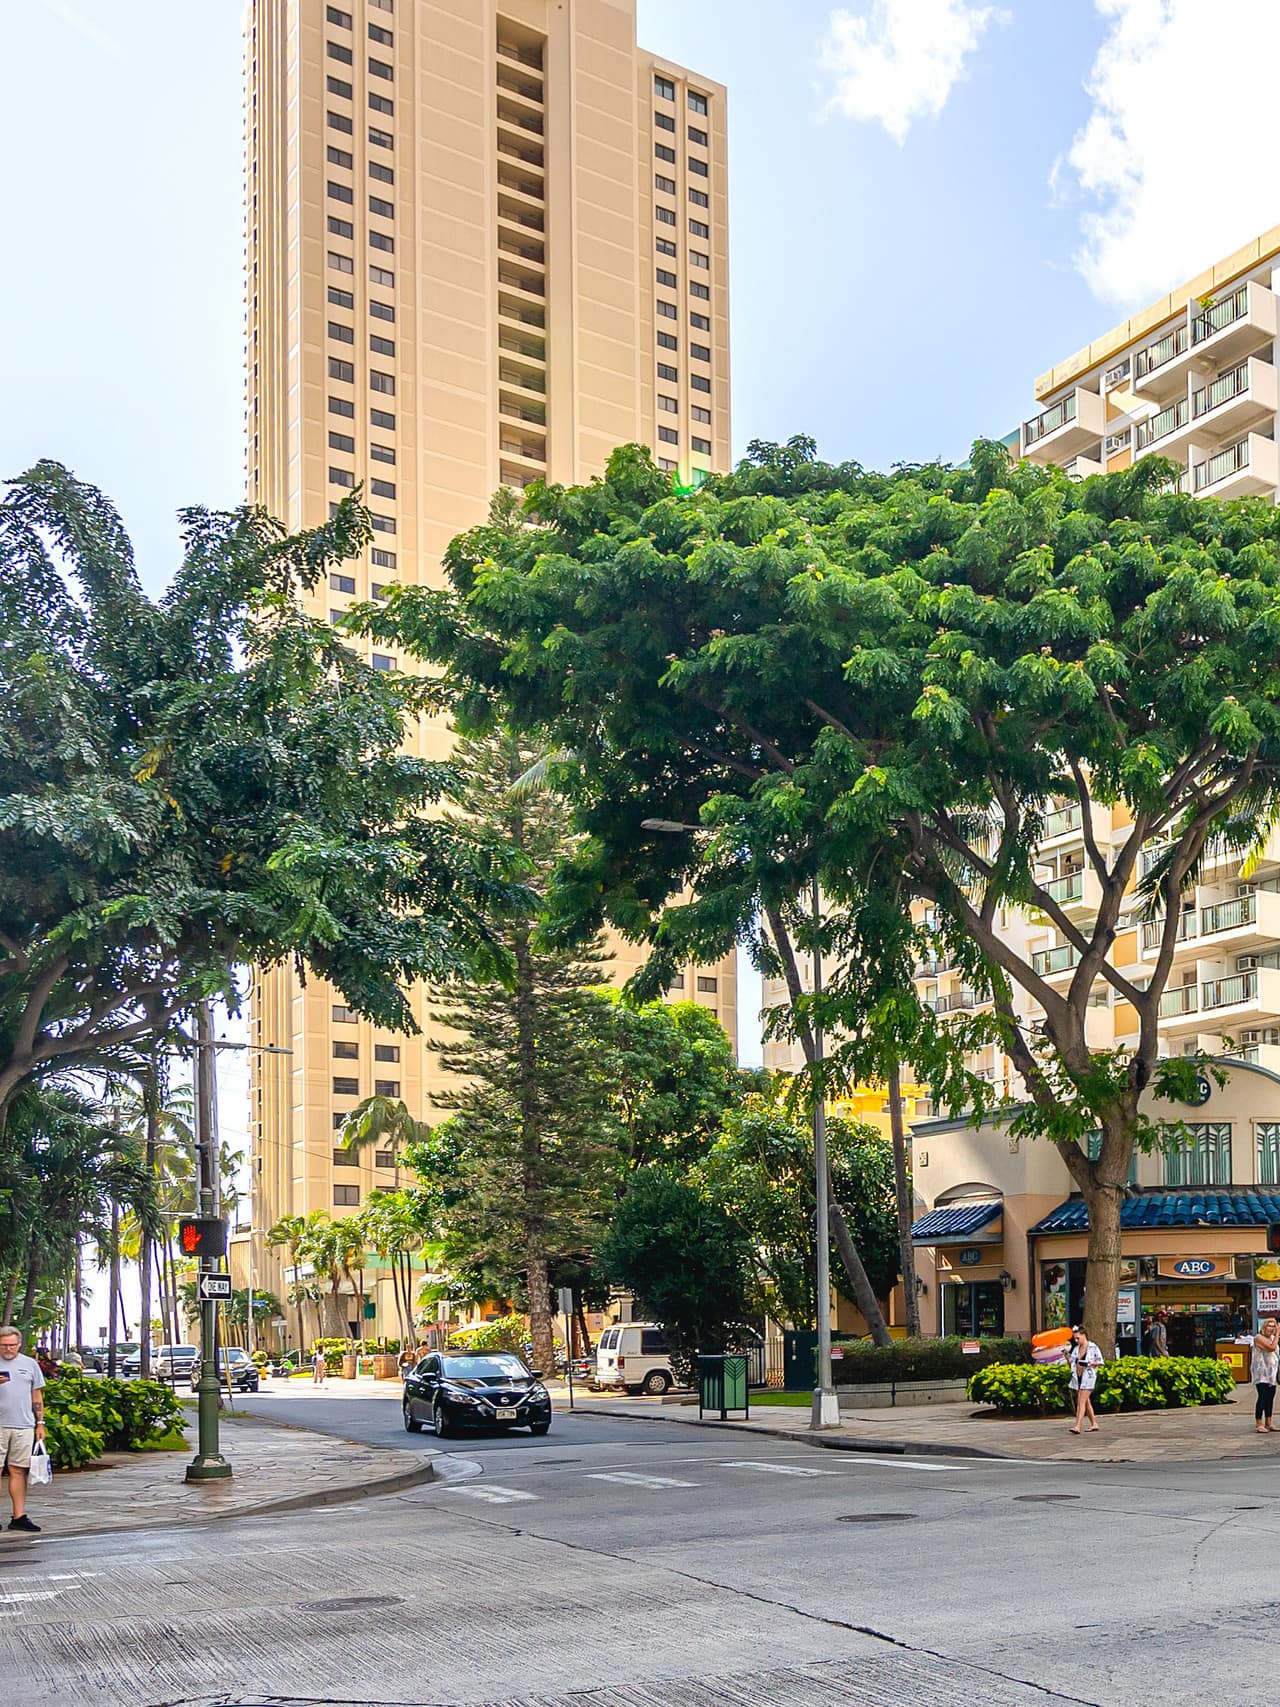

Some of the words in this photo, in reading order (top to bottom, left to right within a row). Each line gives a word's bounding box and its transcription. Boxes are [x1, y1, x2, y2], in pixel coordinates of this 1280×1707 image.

[1180, 1261, 1210, 1273] ABC
[207, 1281, 217, 1292] ONE
[218, 1282, 228, 1291] WAY
